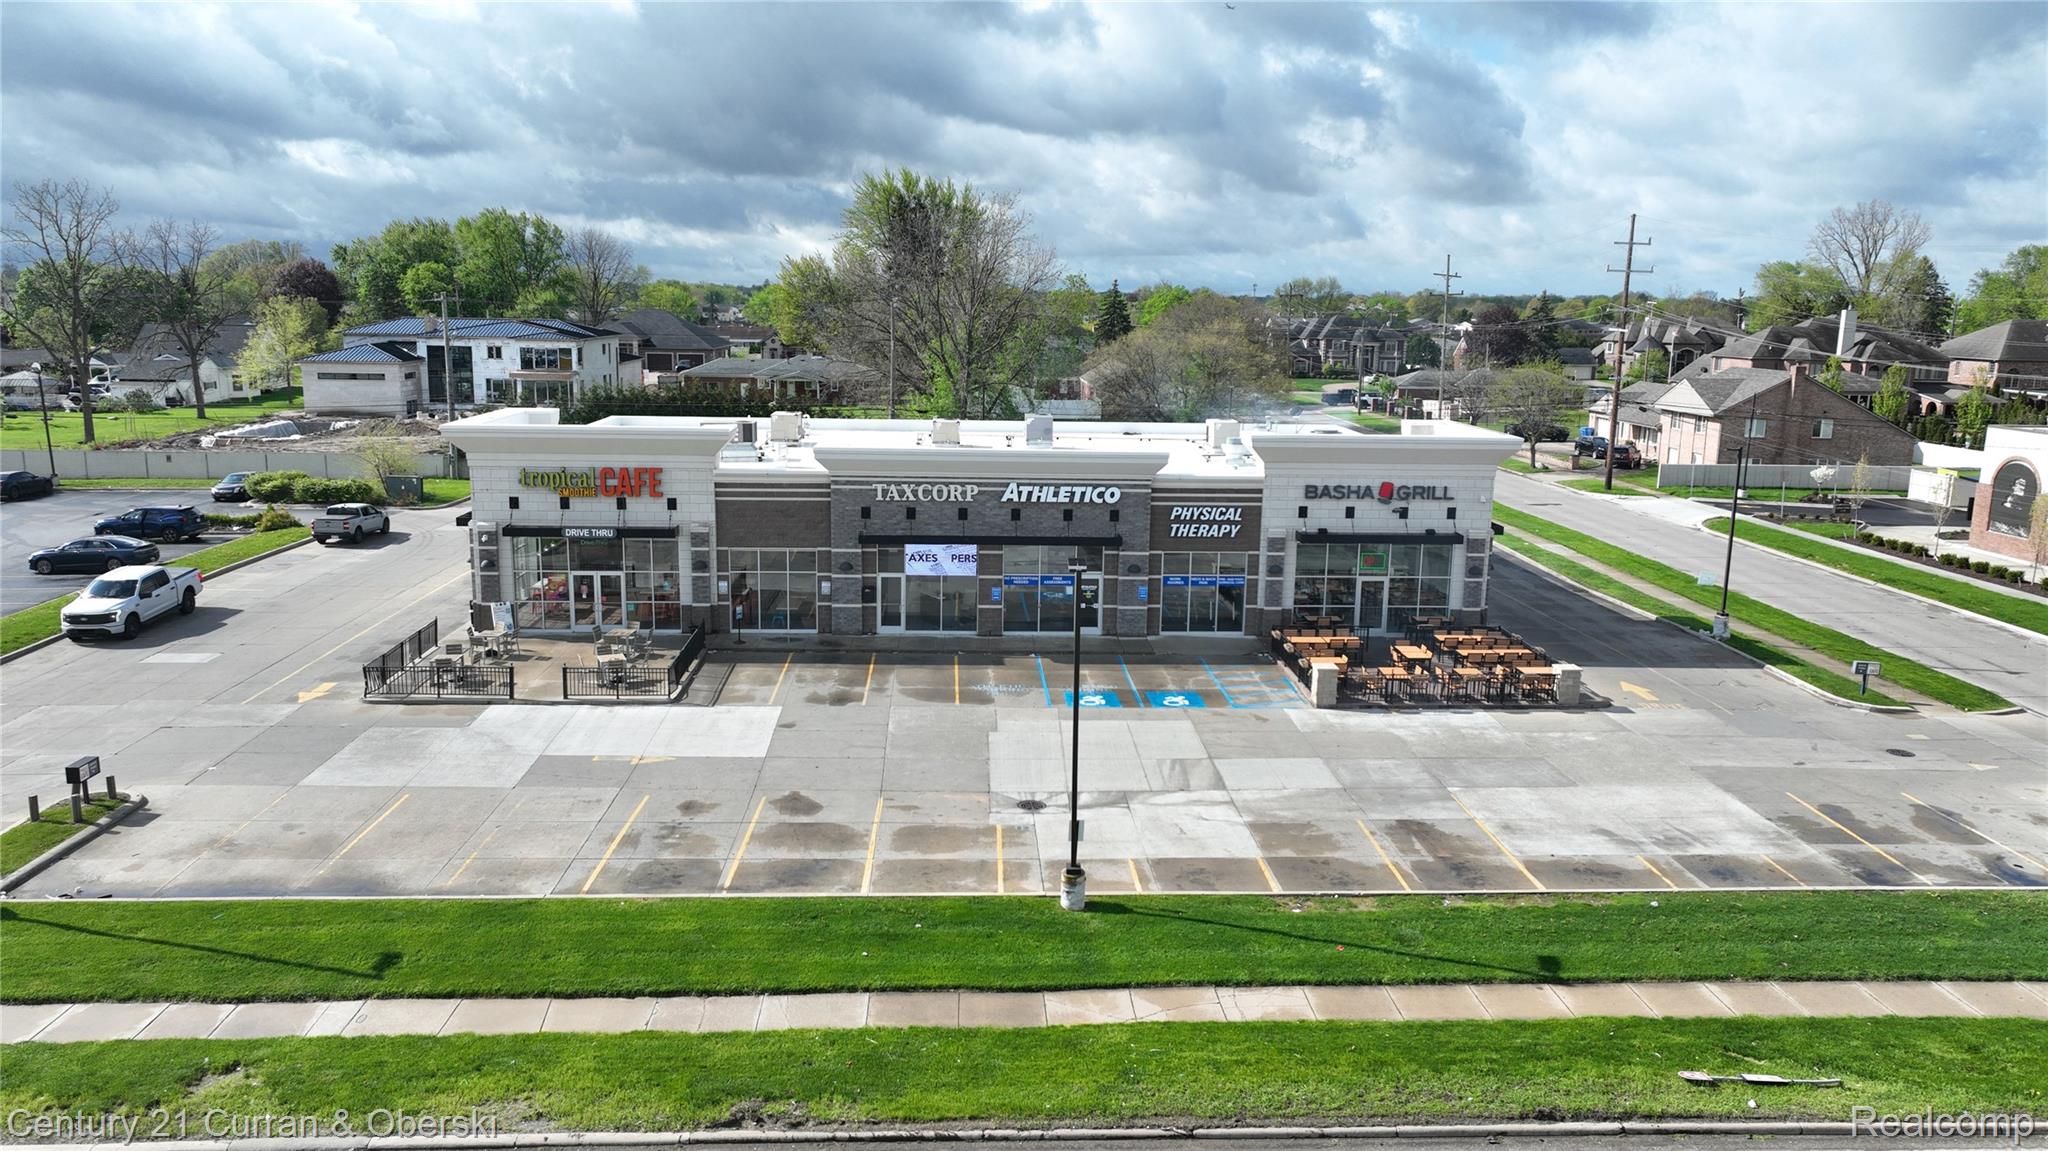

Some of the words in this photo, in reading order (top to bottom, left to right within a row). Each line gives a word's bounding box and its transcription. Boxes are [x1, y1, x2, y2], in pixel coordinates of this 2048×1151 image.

[519, 466, 597, 492] tropical
[599, 467, 664, 497] CAFE
[558, 486, 597, 498] SMOOTHIE
[872, 483, 979, 502] TAXCORP
[1001, 482, 1122, 504] ATHLETICO
[1304, 484, 1375, 500] BASHA
[1396, 485, 1455, 501] GRILL
[1169, 506, 1243, 521] PHYSICAL
[565, 528, 590, 537] DRIVE
[591, 528, 614, 537] THRU
[1169, 524, 1241, 538] THERAPY
[905, 553, 938, 562] AXES
